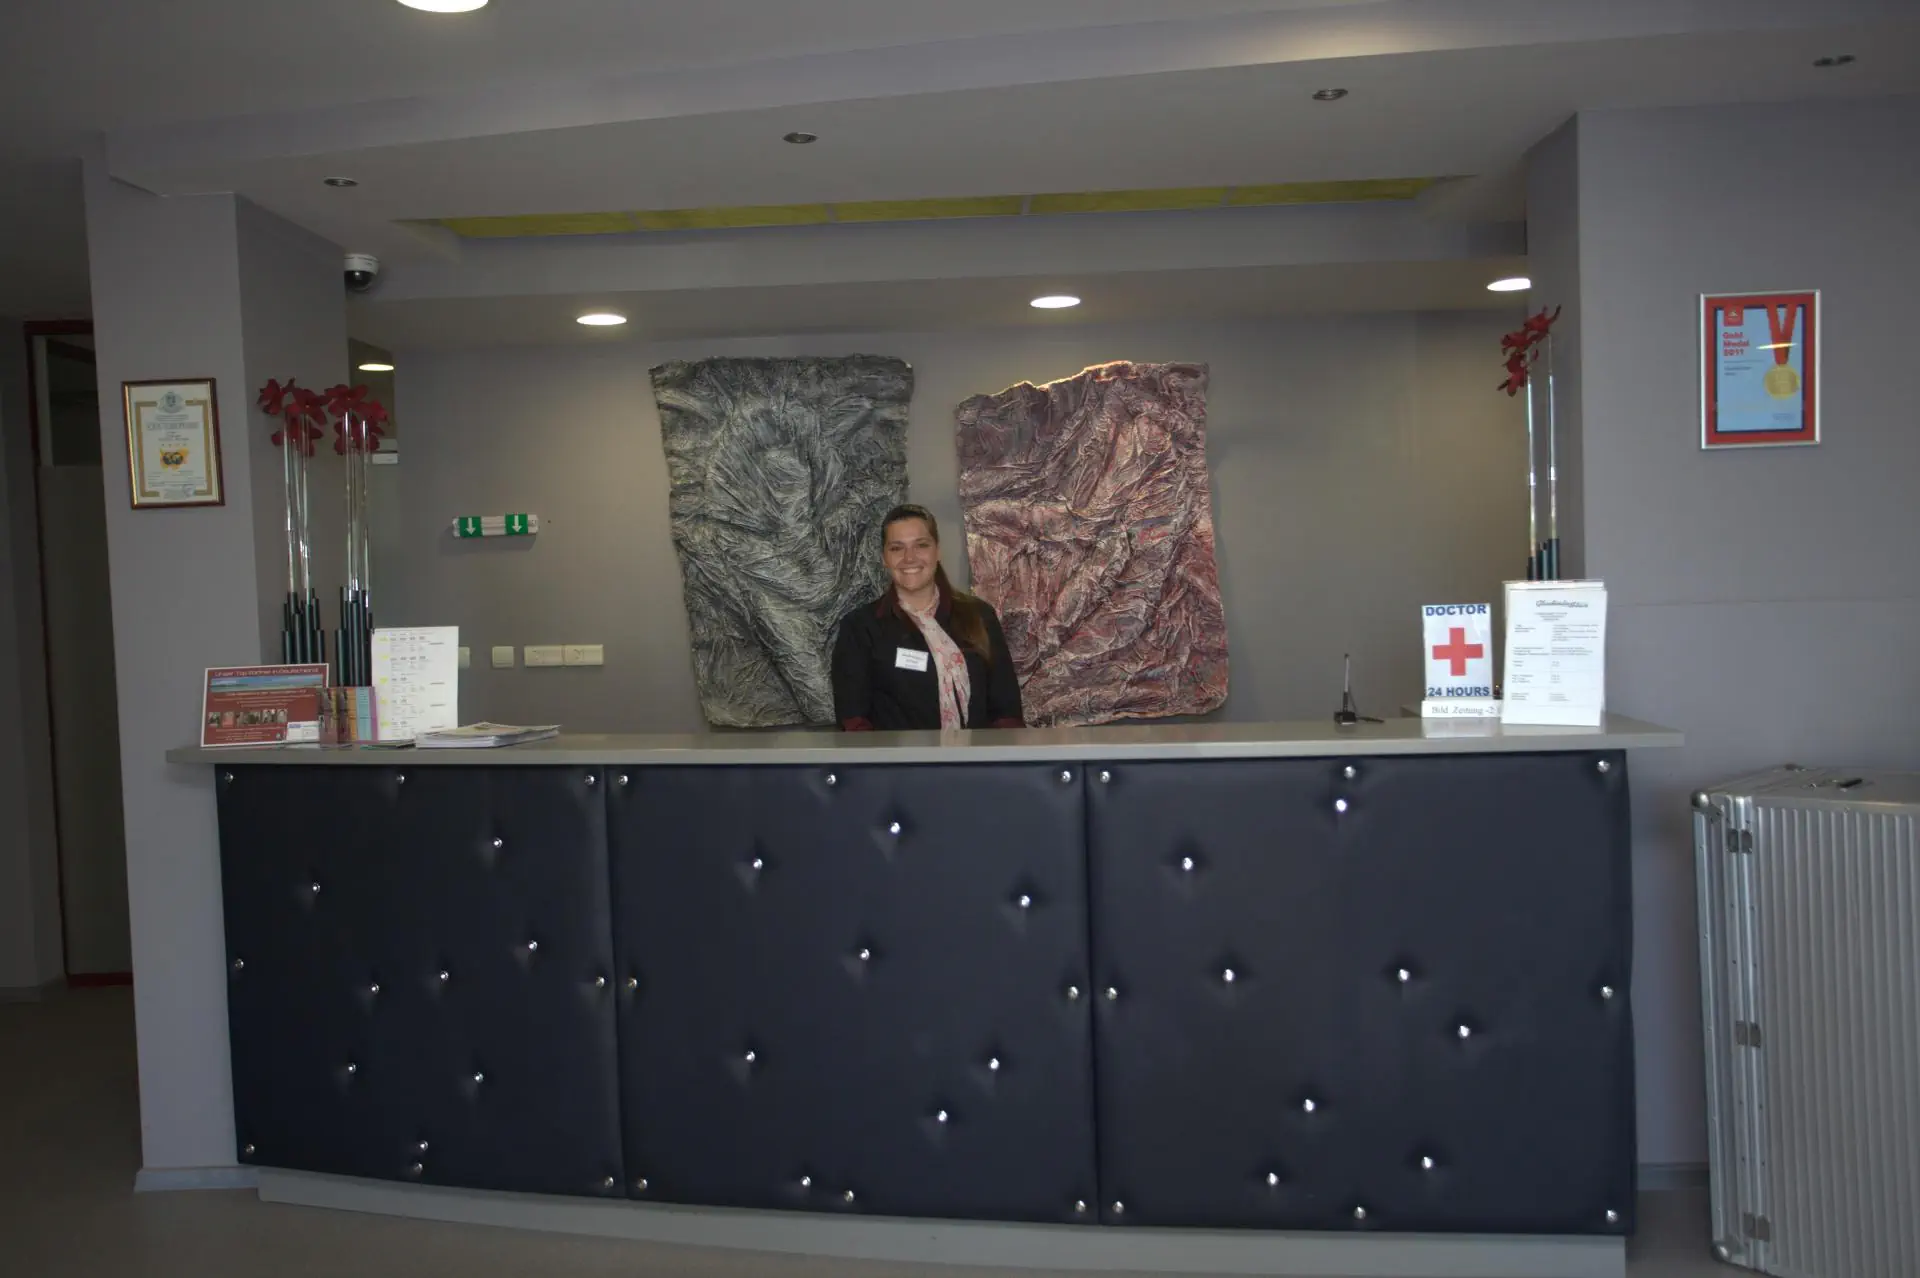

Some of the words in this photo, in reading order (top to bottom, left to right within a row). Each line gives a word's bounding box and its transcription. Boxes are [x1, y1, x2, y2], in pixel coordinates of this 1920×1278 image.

[1722, 331, 1744, 339] Gold
[1723, 339, 1749, 348] Medal
[1425, 604, 1487, 616] DOCTOR
[1428, 687, 1443, 696] 24
[1446, 686, 1490, 696] HOURS
[1431, 705, 1449, 714] Bild
[1452, 705, 1484, 716] Zeitung
